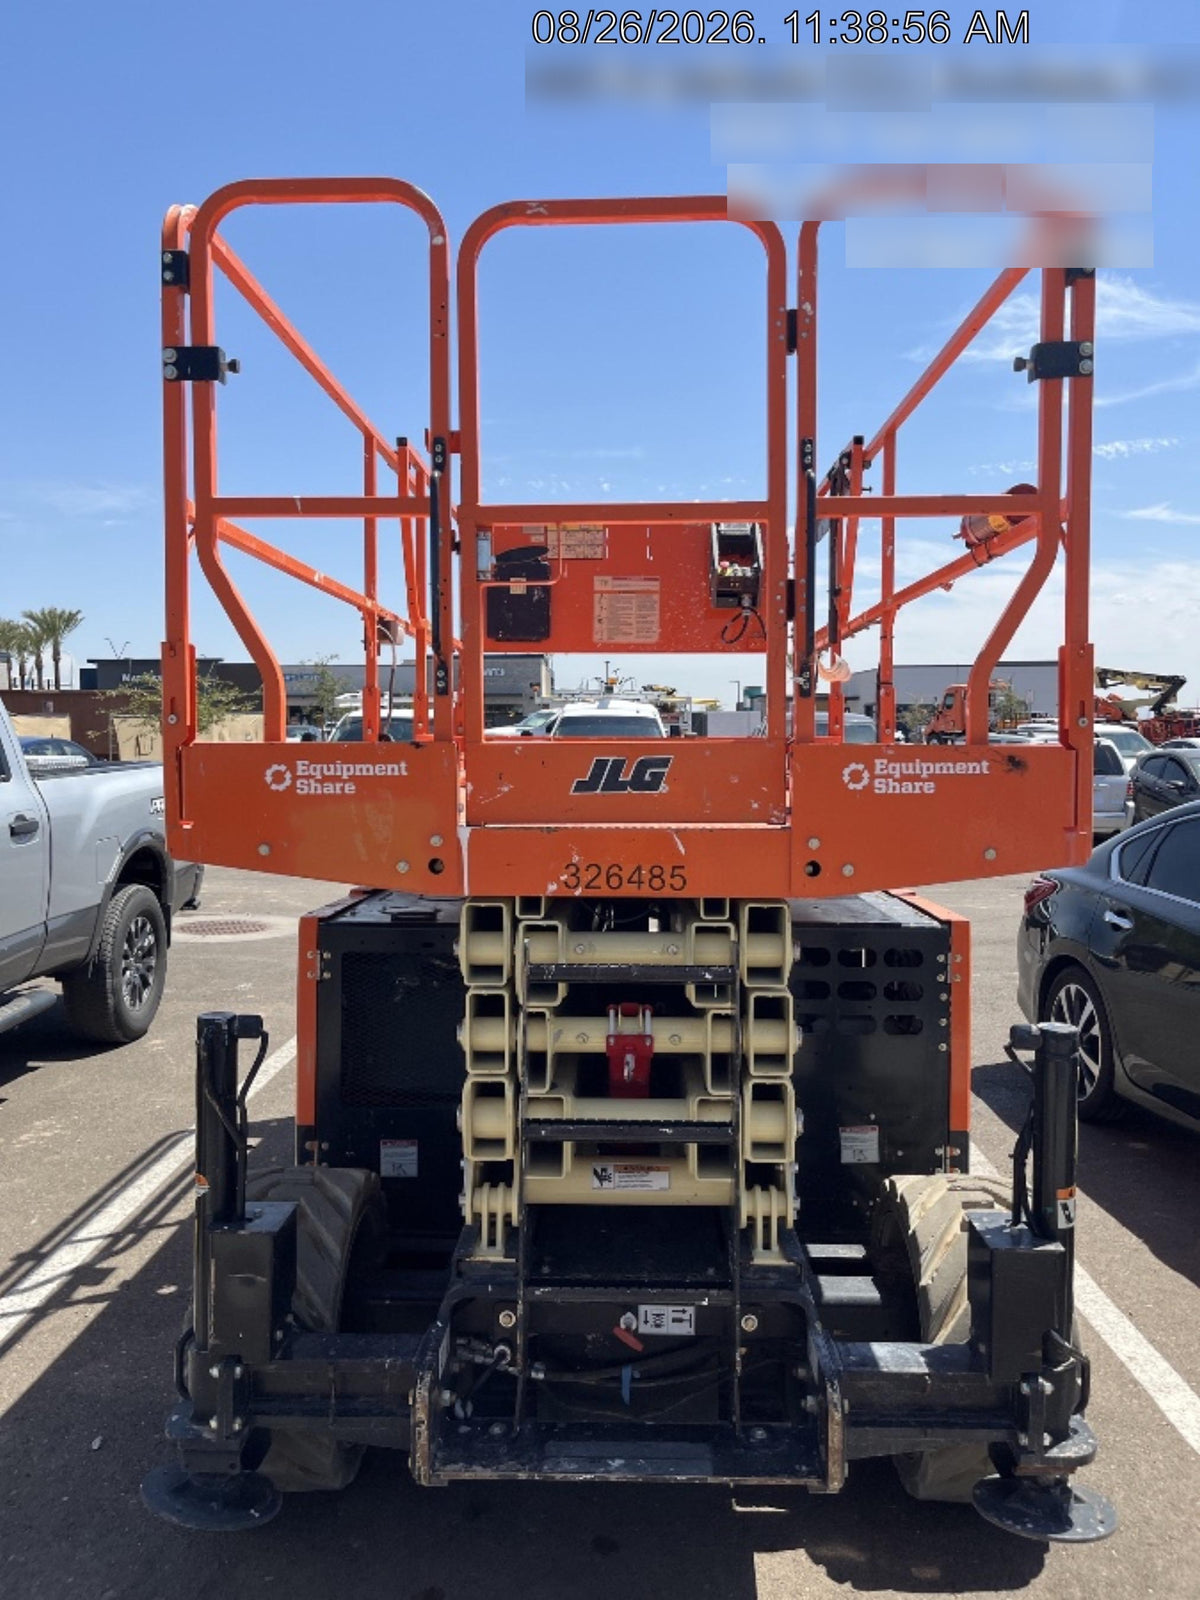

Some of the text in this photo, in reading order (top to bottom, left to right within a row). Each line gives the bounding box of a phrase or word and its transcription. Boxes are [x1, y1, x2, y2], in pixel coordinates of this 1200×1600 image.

[296, 760, 408, 779] Equipment
[569, 755, 674, 795] JLG
[874, 758, 990, 778] Equipment
[296, 778, 356, 795] Share
[874, 778, 936, 794] Share
[563, 863, 688, 892] 326485
